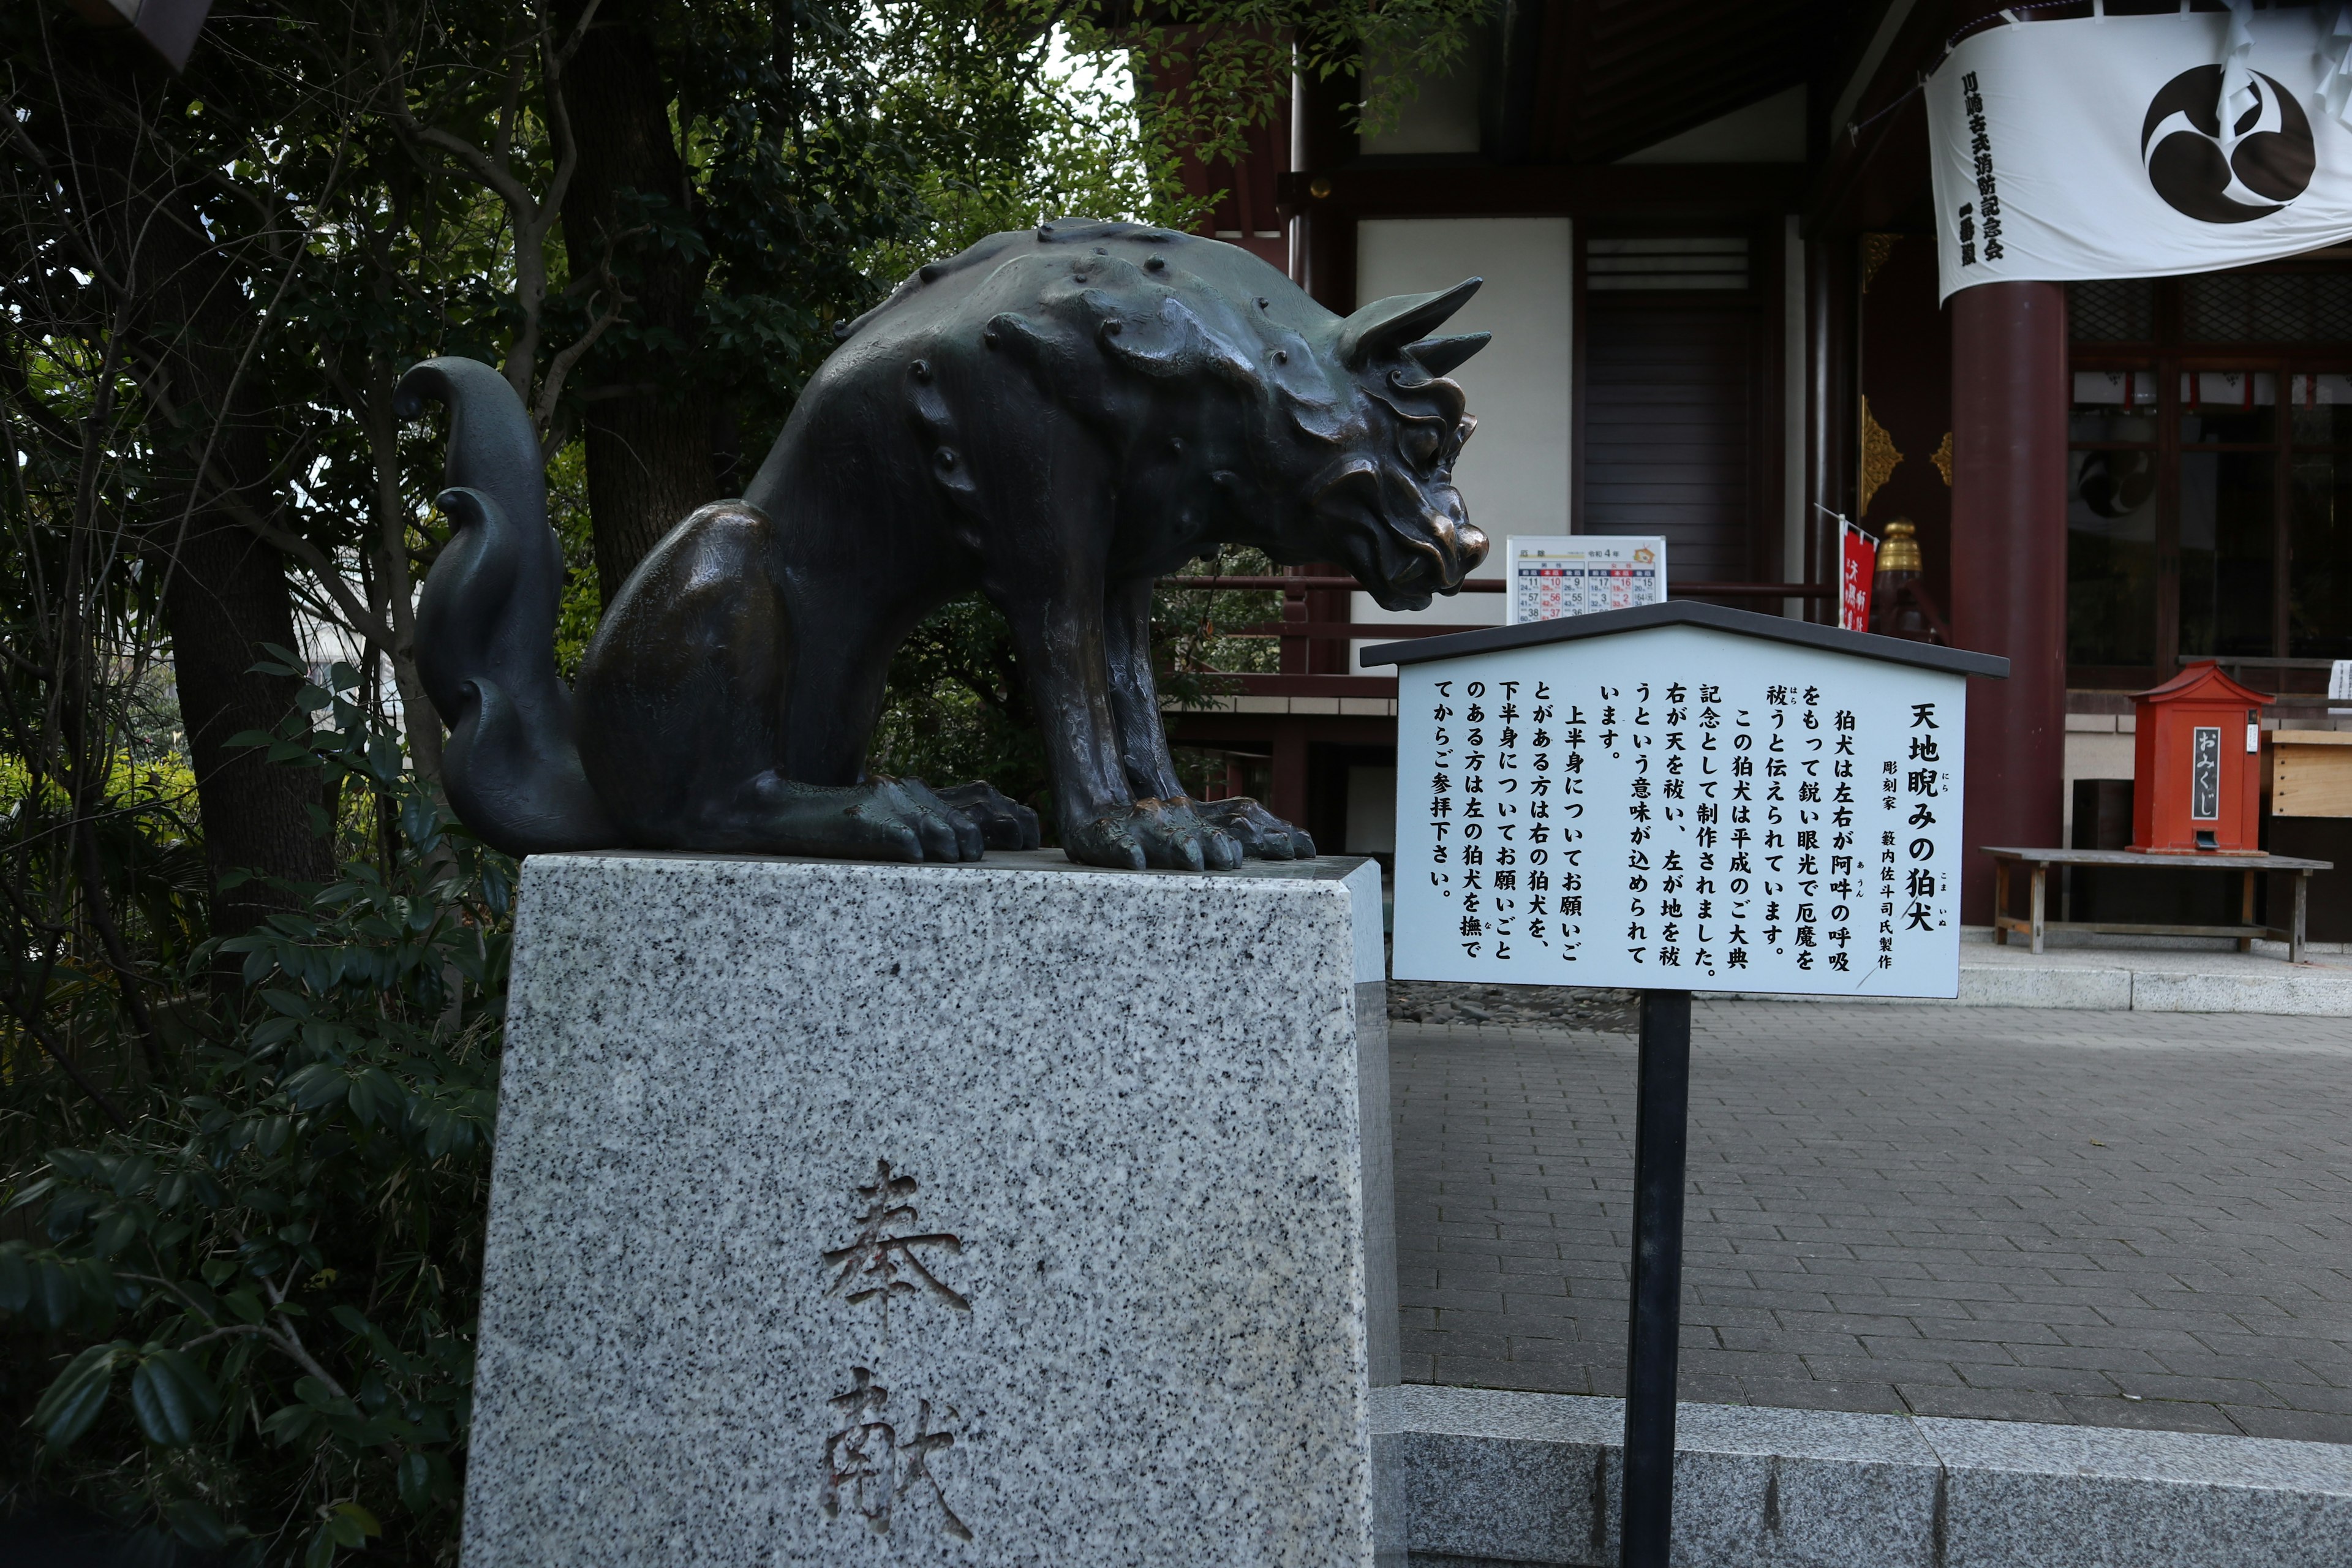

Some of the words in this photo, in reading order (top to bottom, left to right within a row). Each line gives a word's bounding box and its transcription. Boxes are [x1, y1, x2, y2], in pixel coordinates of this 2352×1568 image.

[1528, 608, 1539, 617] 38
[1550, 608, 1560, 617] 37
[1550, 593, 1560, 601] 56
[1572, 593, 1582, 601] 55
[1574, 578, 1580, 586] 9
[1599, 578, 1608, 586] 17
[1621, 578, 1631, 586] 16
[1601, 594, 1607, 602] 3
[1623, 594, 1629, 602] 2
[1790, 687, 1798, 705] はら
[1430, 681, 1453, 897] てからご参拝下さい。
[1460, 682, 1485, 958] のある方は左の狛犬を撫で
[1494, 681, 1520, 959] 下半身についてお願いごと
[1527, 681, 1553, 947] とがある方は右の狛犬を、
[1559, 706, 1586, 961] 上半身についてお願いご
[1599, 686, 1619, 758] います。
[1627, 683, 1651, 963] うという意味が込められて
[1695, 684, 1722, 976] 記念として制作されました。
[1762, 685, 1789, 954] 祓うと伝えられています。
[1795, 685, 1822, 970] をもって鋭い眼光で厄魔を
[1882, 761, 1898, 810] 彫刻家
[1905, 703, 1940, 932] 天地睨みの狛犬
[1942, 772, 1950, 793] にら
[2197, 731, 2216, 815] おみくじ
[1727, 710, 1752, 969] この狛犬は平成のご大典
[1828, 710, 1855, 971] 狛犬は左右が阿吽の呼吸
[823, 1159, 973, 1542] 奉献
